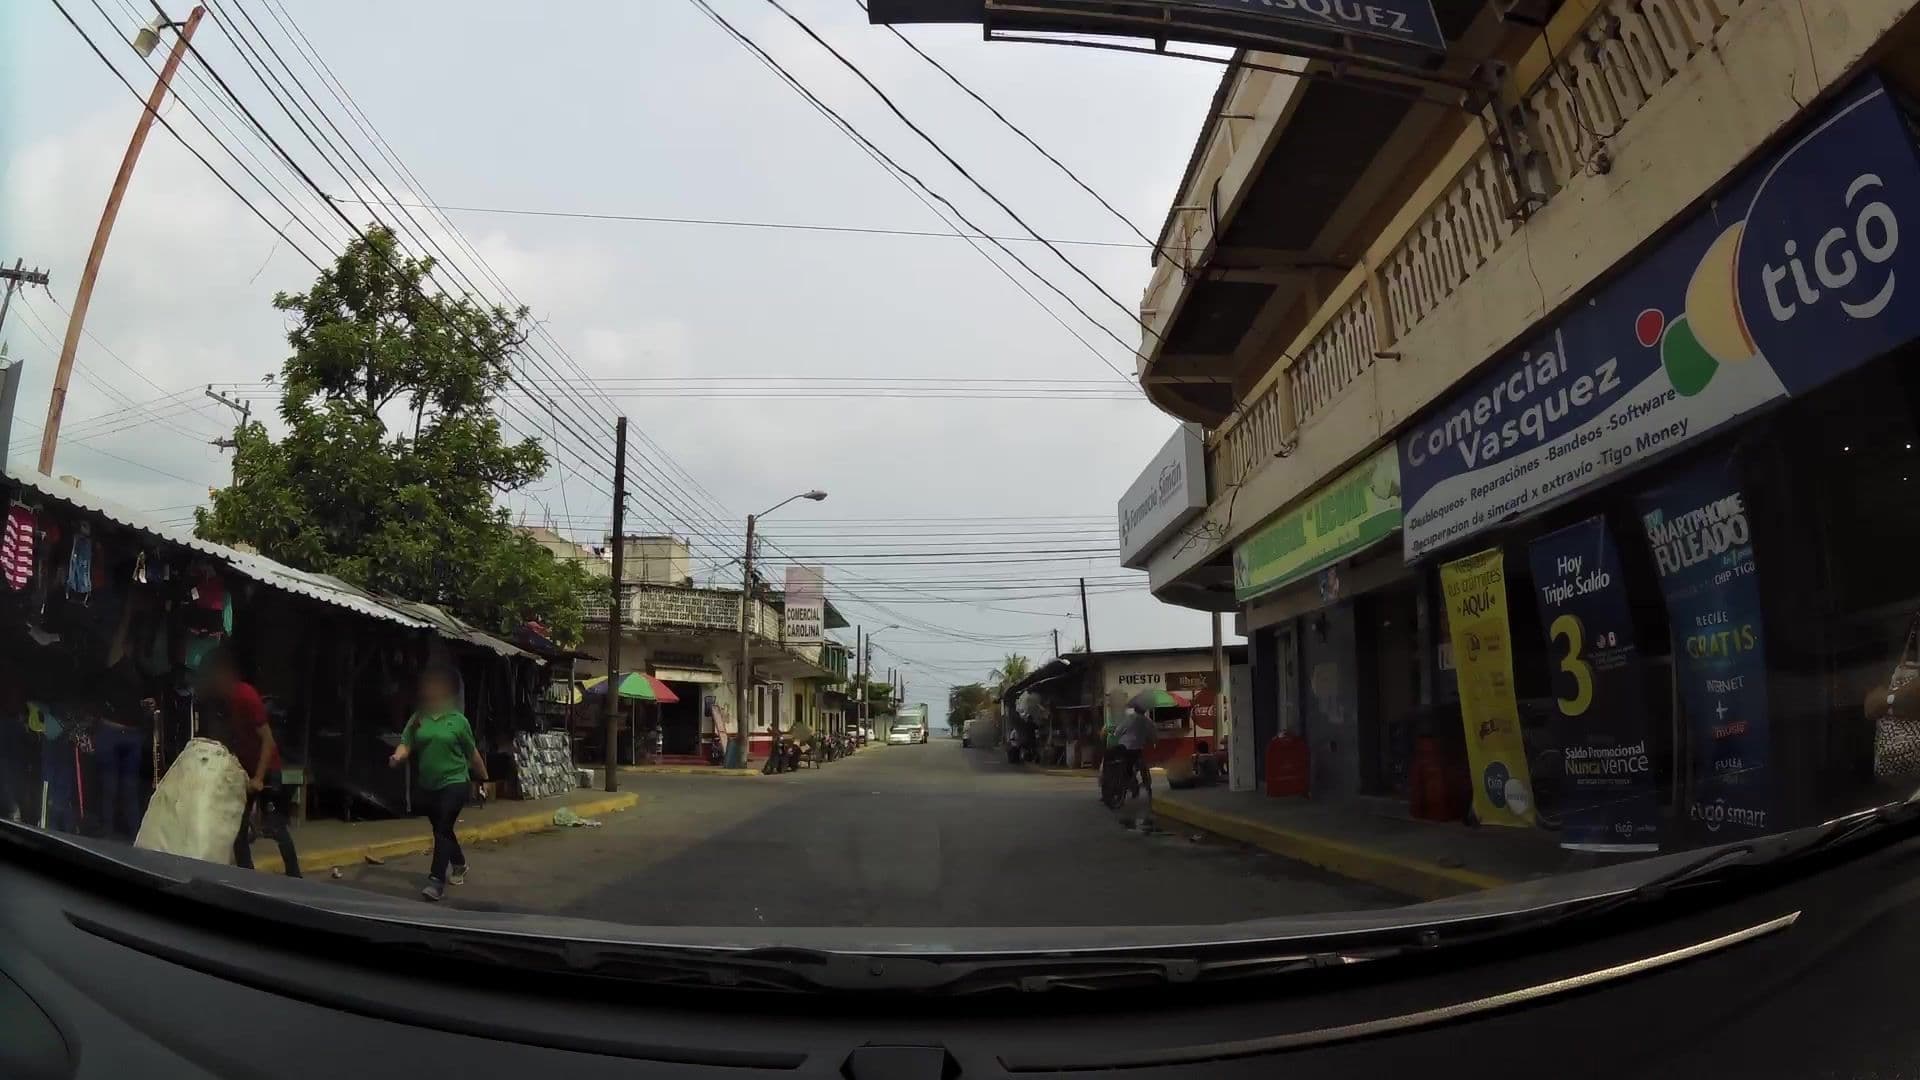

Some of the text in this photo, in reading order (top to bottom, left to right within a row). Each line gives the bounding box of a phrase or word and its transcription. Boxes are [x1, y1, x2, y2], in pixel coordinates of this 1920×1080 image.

[1240, 0, 1413, 33] QUEZ
[1407, 328, 1569, 468] Comercial
[1458, 356, 1622, 469] Vasquez
[1472, 511, 1485, 526] de
[1487, 488, 1528, 520] simcard
[1531, 487, 1539, 498] x
[1636, 416, 1689, 453] Money
[1556, 555, 1582, 577] Hoy
[1541, 568, 1610, 607] Triple Saldo
[786, 607, 820, 621] COMERCIAL
[787, 623, 820, 638] CAROLINA
[1118, 673, 1160, 685] PUESTO
[1549, 613, 1594, 717] 3
[1727, 807, 1766, 828] smart
